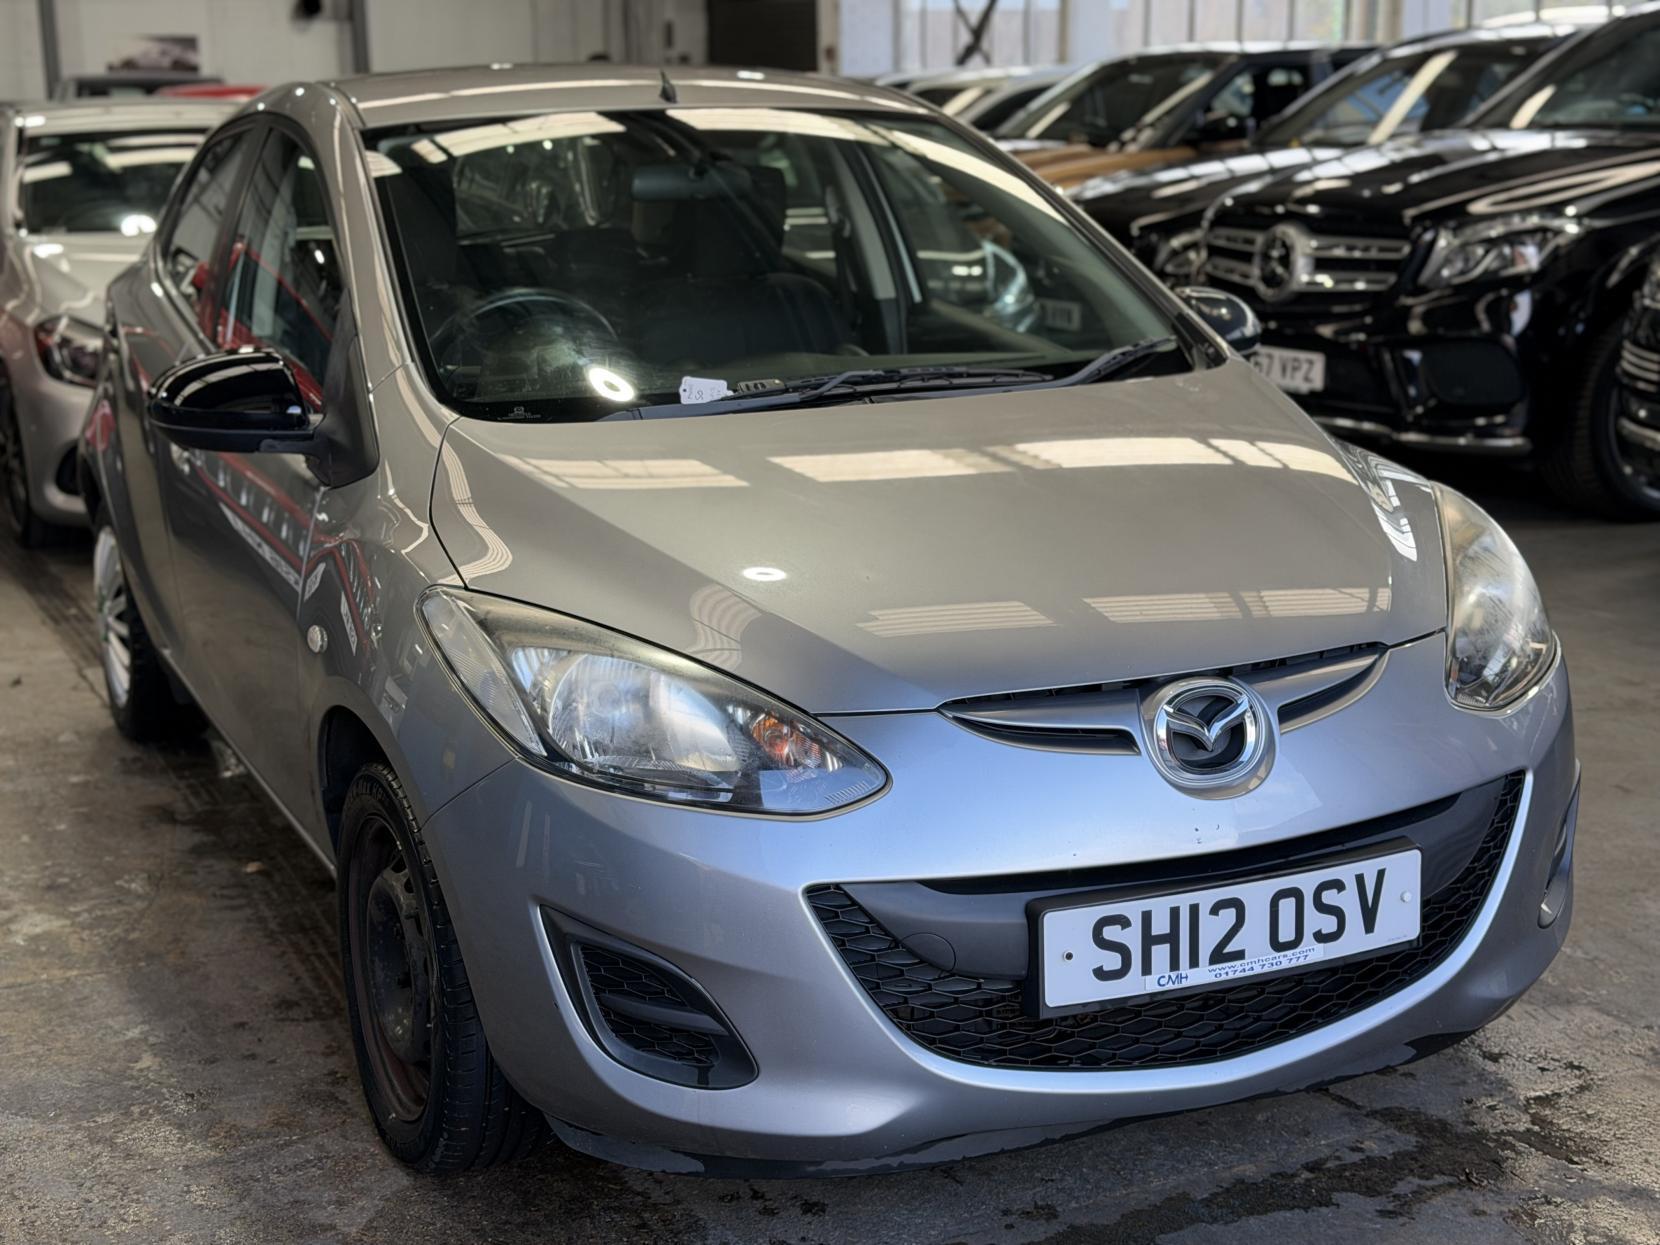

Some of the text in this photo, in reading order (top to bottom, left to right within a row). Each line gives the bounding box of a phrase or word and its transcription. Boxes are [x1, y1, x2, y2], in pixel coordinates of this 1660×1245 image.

[1091, 867, 1387, 982] SH12 OSV
[1207, 946, 1316, 974] www.cmhcars.com
[1214, 954, 1311, 979] 01744 730 777
[1156, 972, 1189, 988] CMH
